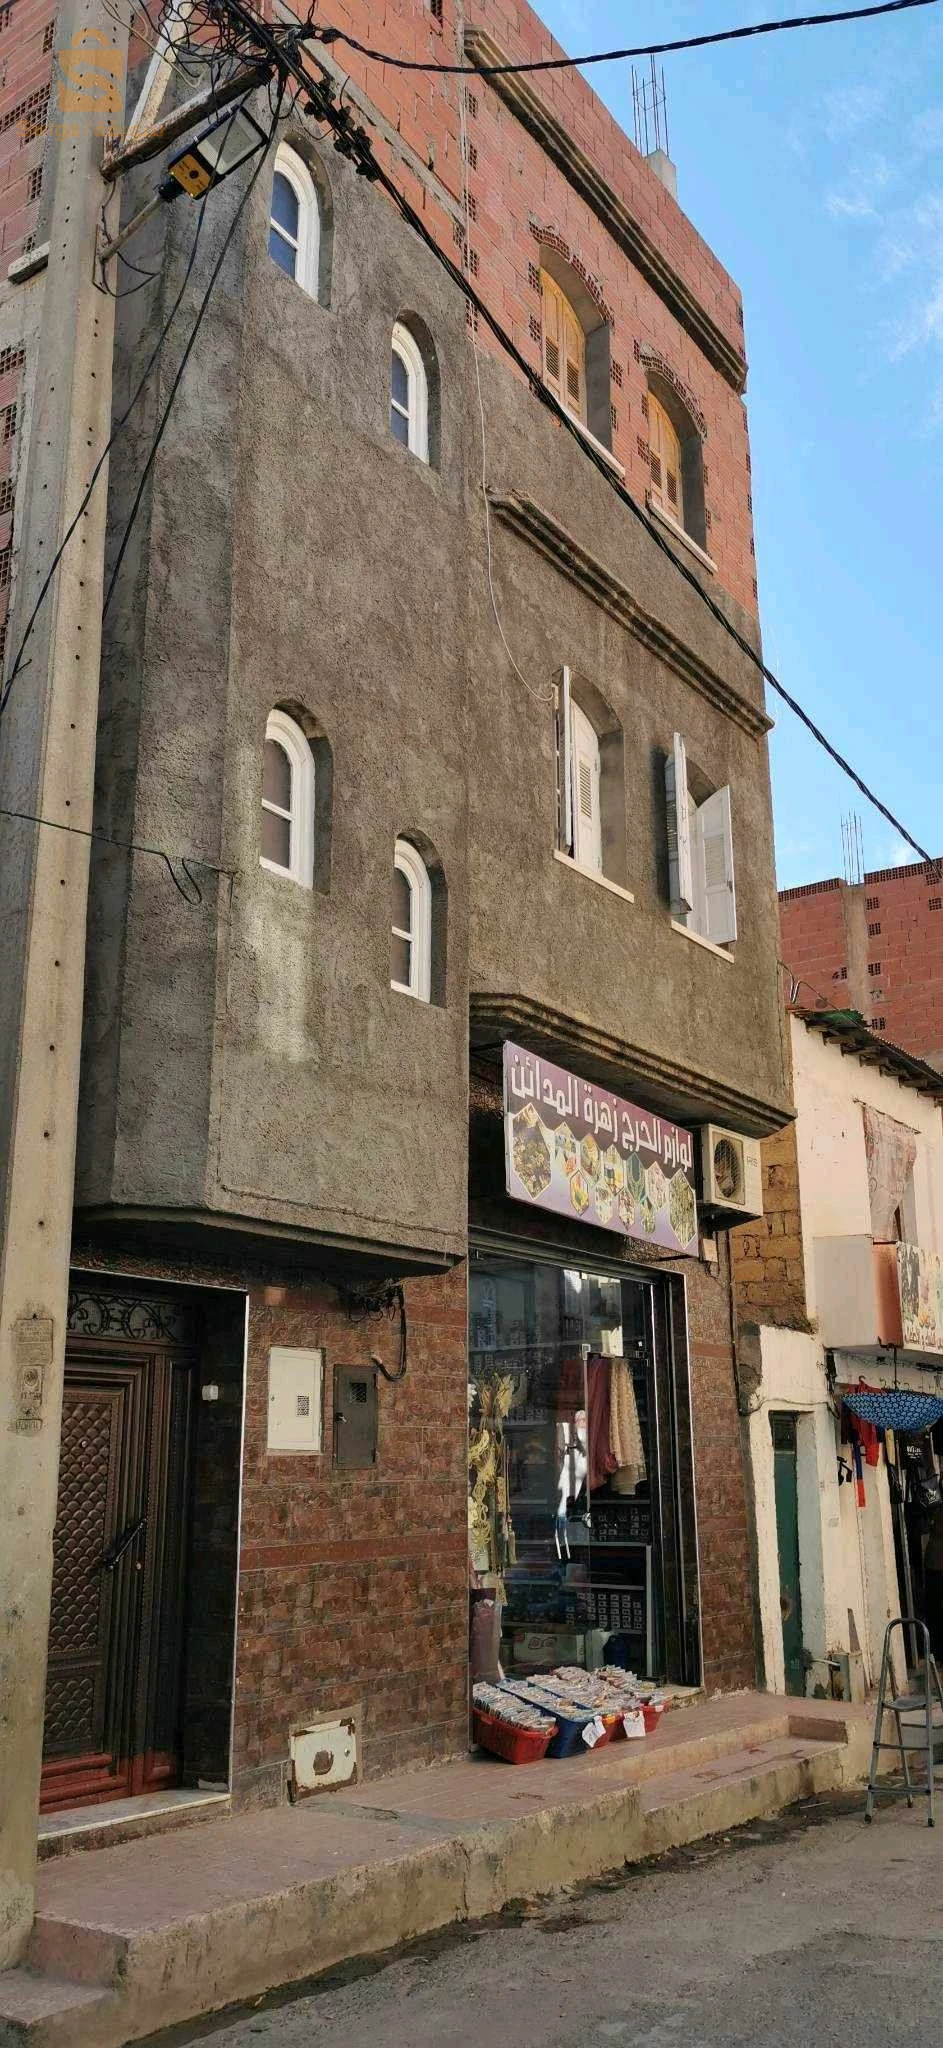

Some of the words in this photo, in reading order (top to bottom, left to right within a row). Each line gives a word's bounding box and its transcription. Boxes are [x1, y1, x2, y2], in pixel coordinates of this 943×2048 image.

[511, 1054, 579, 1118] المدائن
[583, 1083, 618, 1143] زهرة
[663, 1126, 692, 1173] لوازم
